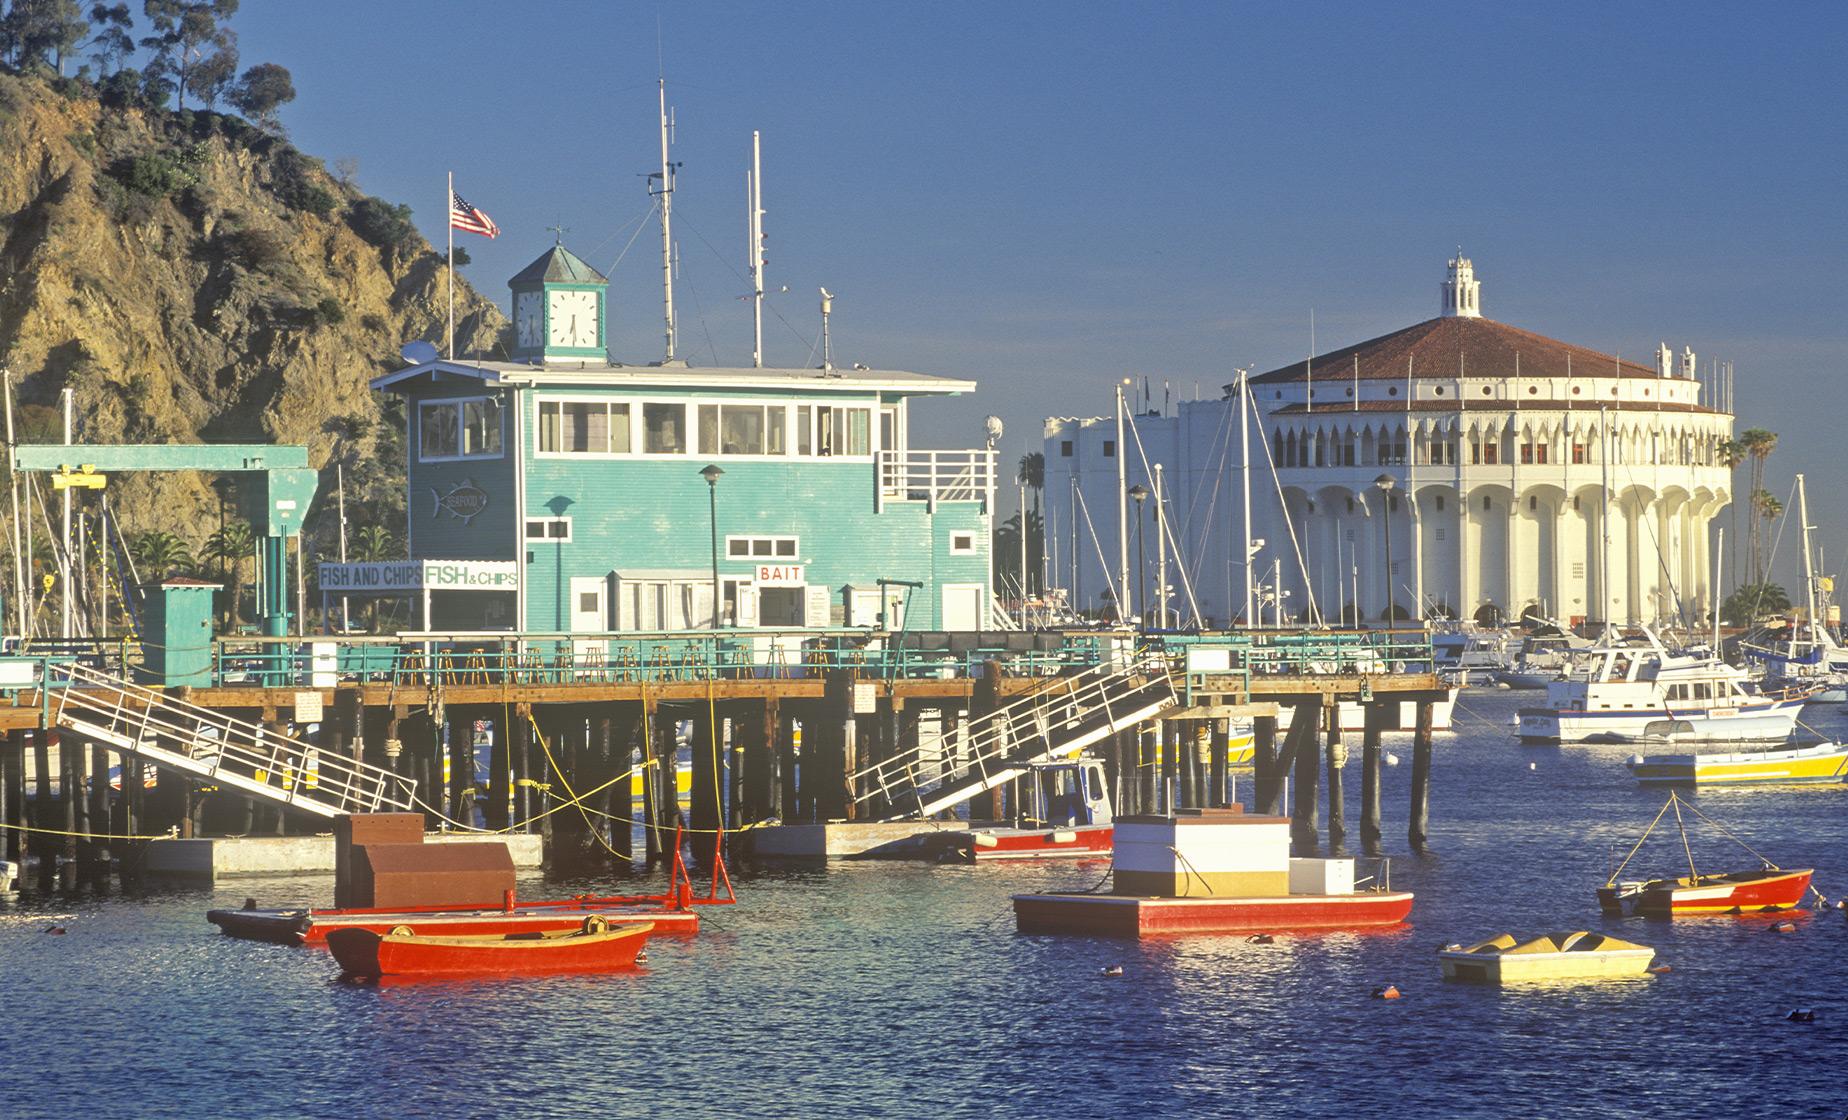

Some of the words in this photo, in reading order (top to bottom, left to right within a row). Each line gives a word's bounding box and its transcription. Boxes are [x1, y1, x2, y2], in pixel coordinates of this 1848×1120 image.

[320, 567, 349, 586] FISH
[353, 567, 380, 585] AND
[383, 566, 422, 585] CHIPS
[425, 566, 468, 584] FISH
[469, 574, 476, 584] &
[477, 571, 518, 585] CHIPS
[761, 567, 800, 580] BAIT
